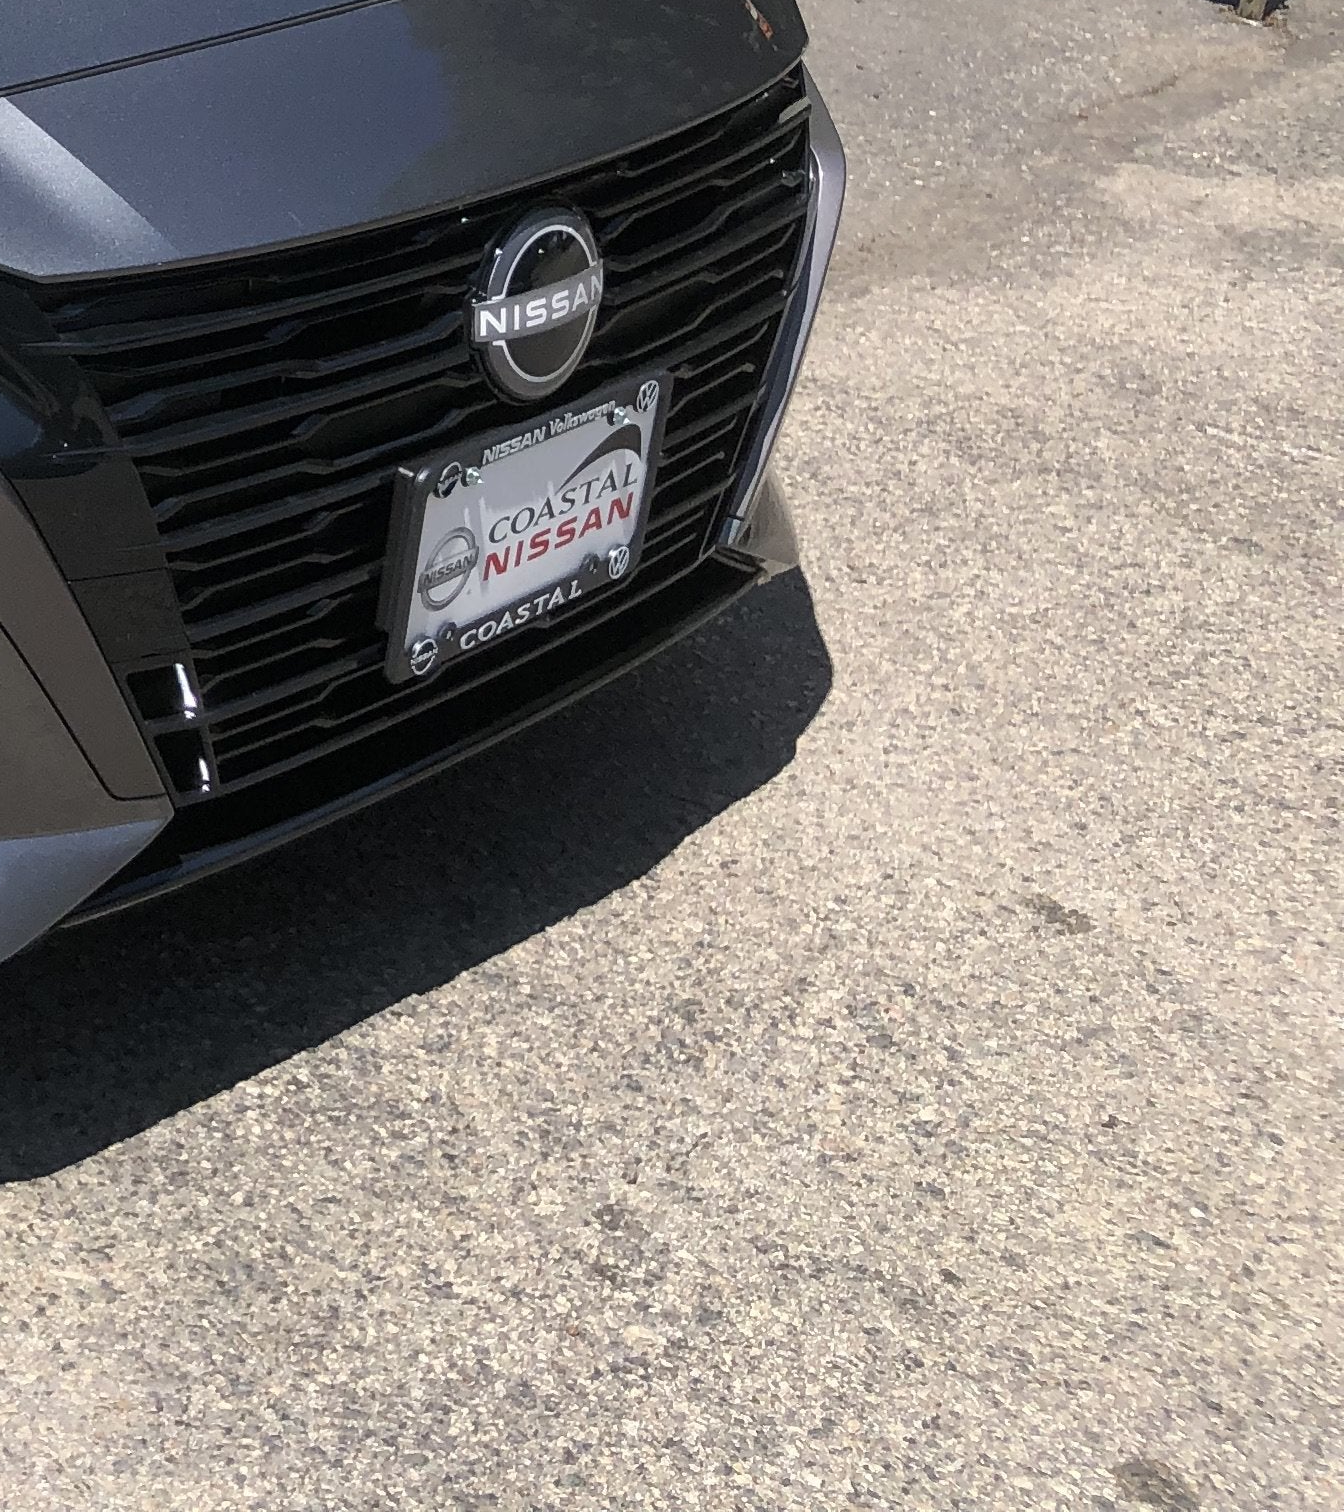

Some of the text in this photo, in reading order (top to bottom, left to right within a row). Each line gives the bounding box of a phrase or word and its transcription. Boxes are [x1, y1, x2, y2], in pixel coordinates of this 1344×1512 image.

[479, 274, 602, 337] NISSAN
[482, 400, 616, 465] NISSAN Volkswagen
[482, 491, 634, 582] NISSAN
[488, 462, 638, 544] COASTAL
[421, 553, 473, 586] NISSAN
[460, 579, 583, 650] COASTAL
